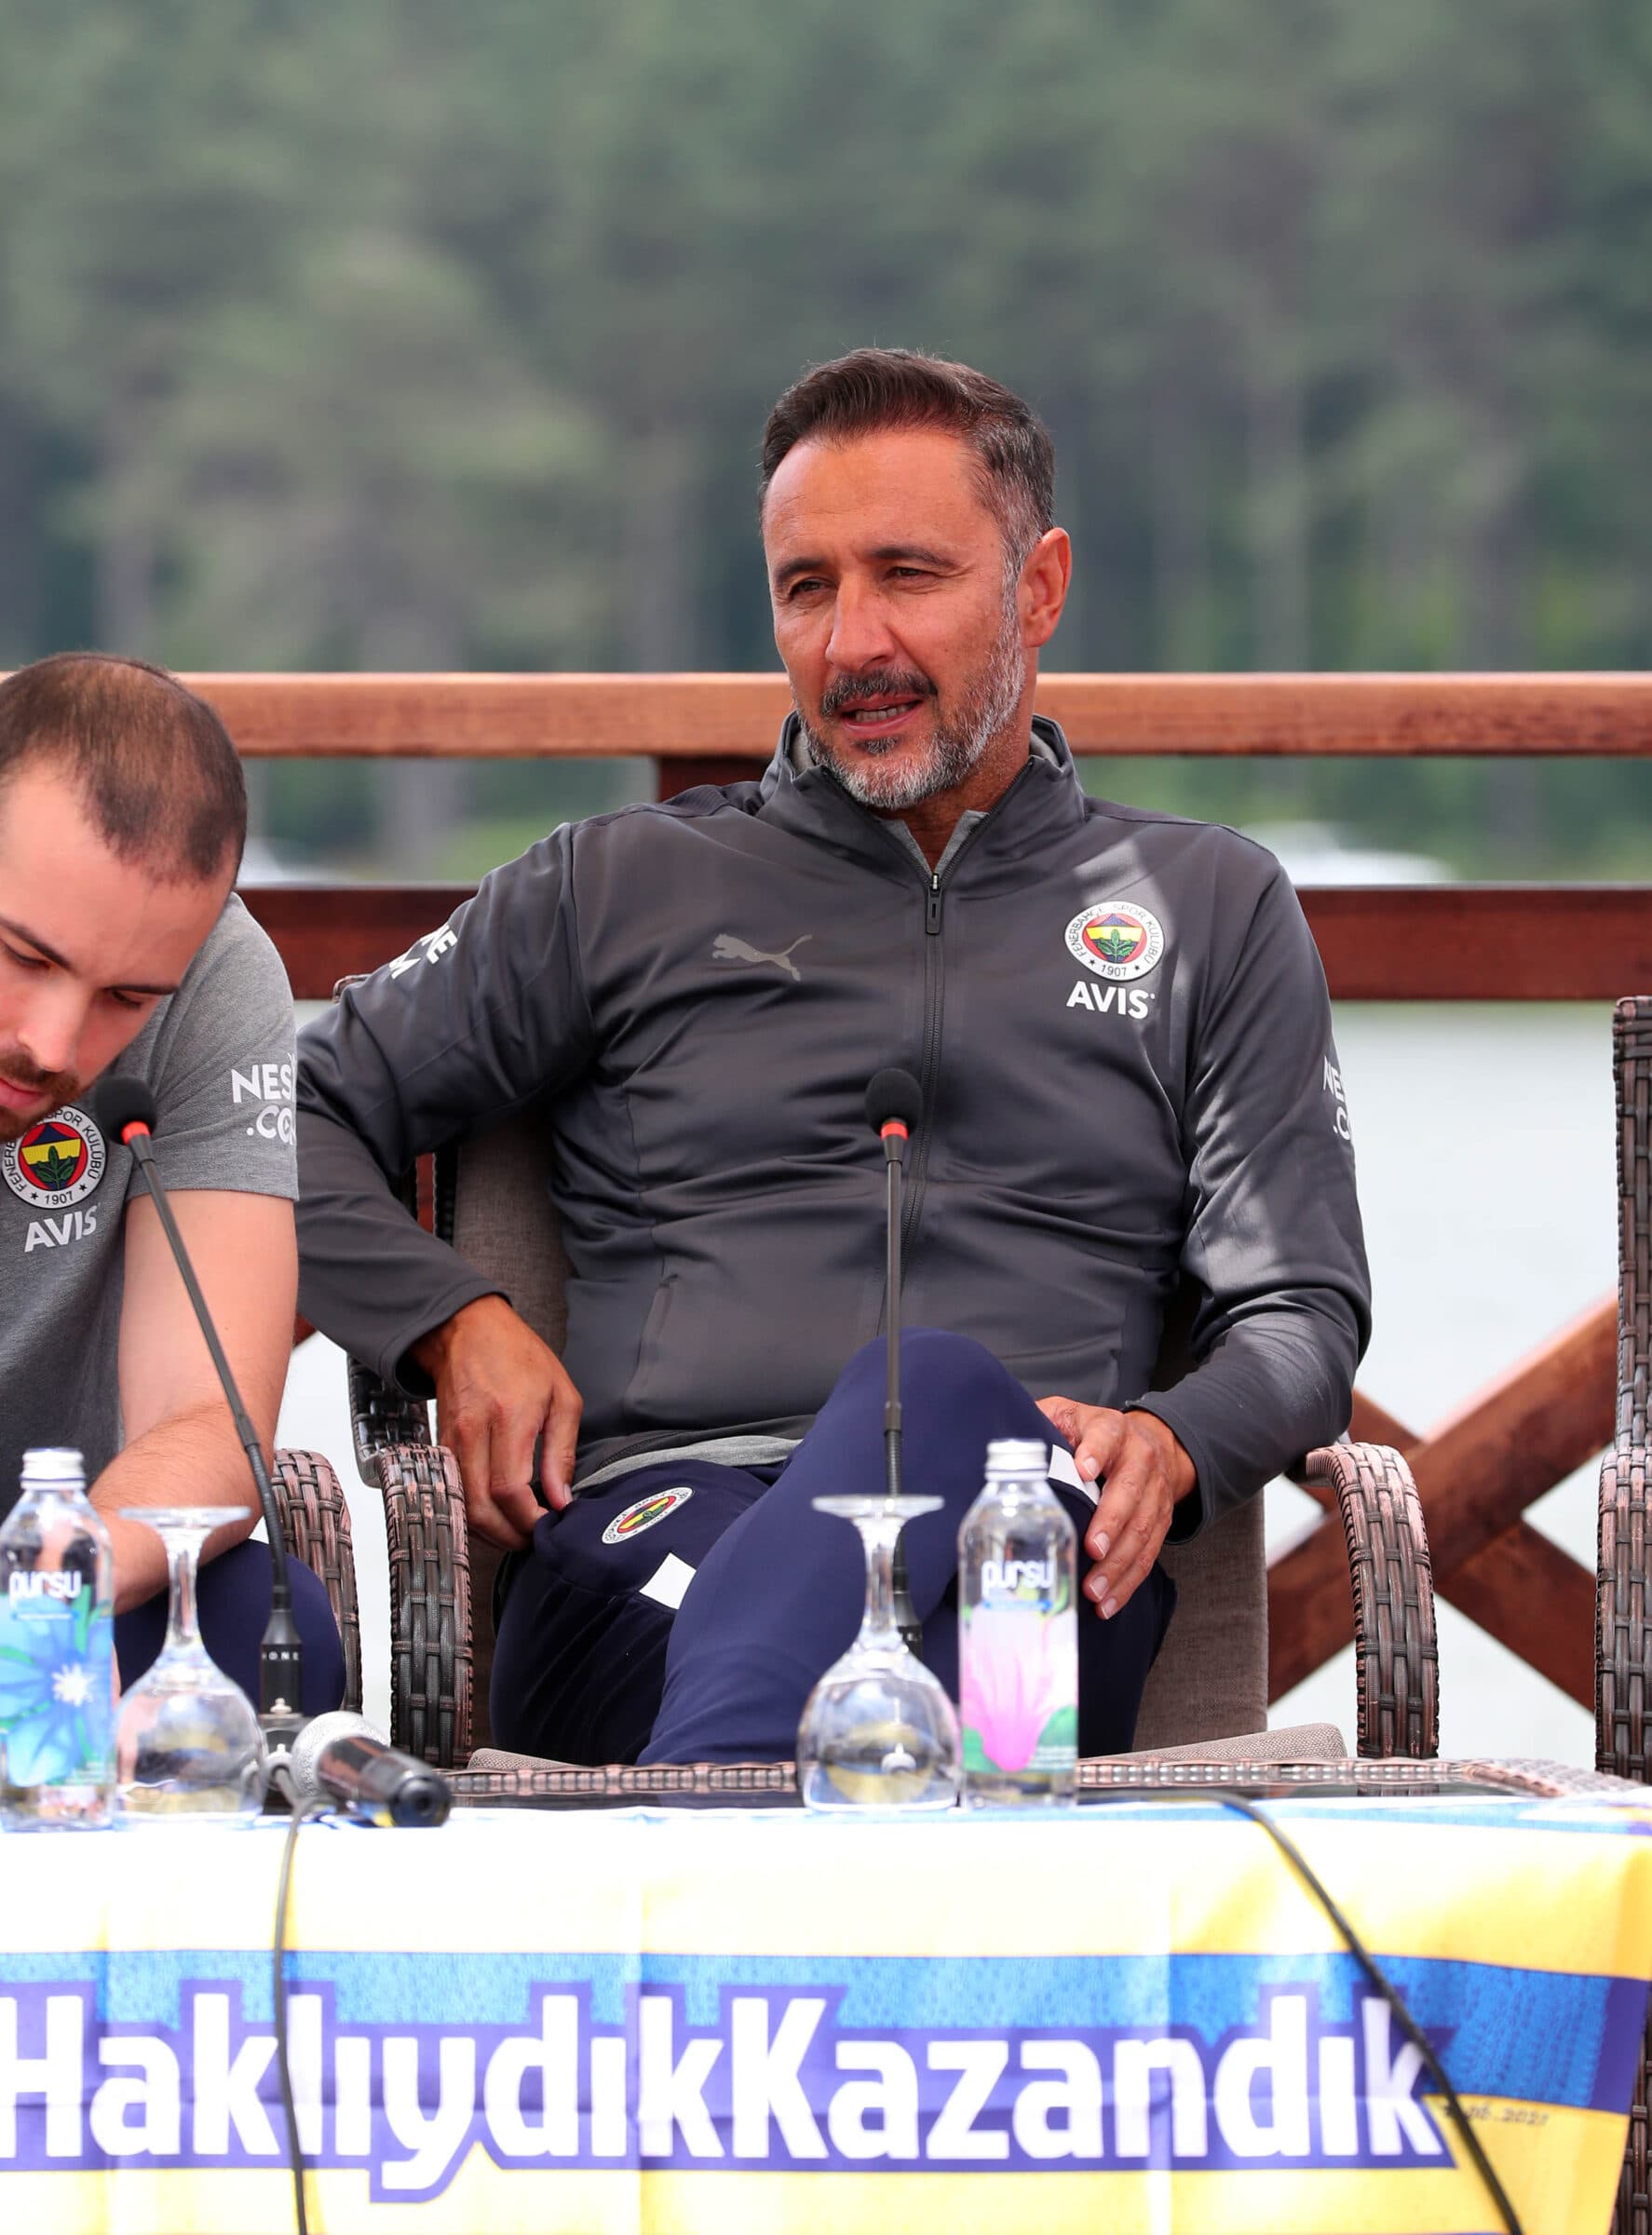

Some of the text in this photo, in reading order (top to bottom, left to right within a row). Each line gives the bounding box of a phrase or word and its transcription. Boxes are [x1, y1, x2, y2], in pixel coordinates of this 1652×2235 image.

[1101, 965, 1128, 977] 1907
[1065, 981, 1152, 1020] AVIS
[82, 1124, 103, 1180] KULÜBÜ
[45, 1190, 74, 1205] 1907
[24, 1205, 98, 1253] AVIS
[9, 1570, 82, 1612] pursu
[981, 1560, 1054, 1600] pursu
